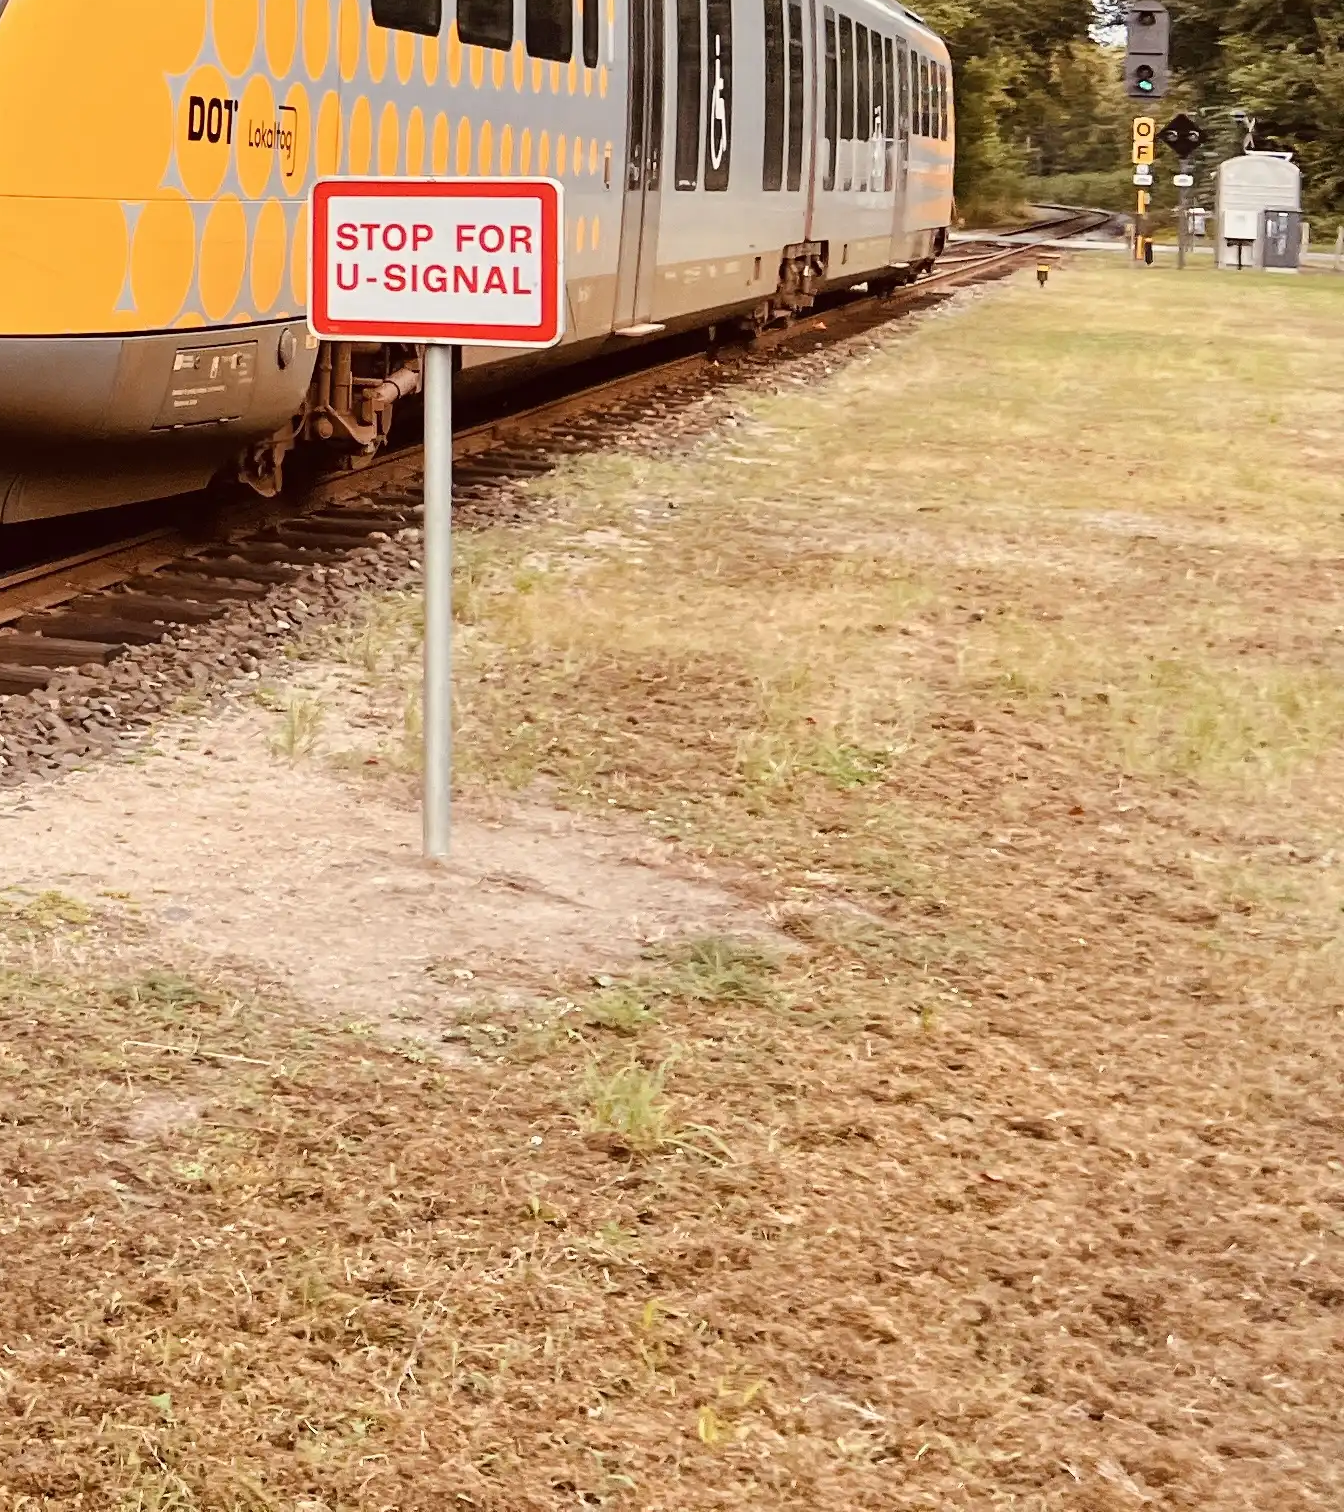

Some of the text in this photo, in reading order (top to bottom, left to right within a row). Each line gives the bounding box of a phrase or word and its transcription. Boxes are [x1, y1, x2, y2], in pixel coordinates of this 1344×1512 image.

[1137, 145, 1148, 159] F
[336, 223, 533, 254] STOP FOR
[336, 263, 532, 295] U-SIGNAL
